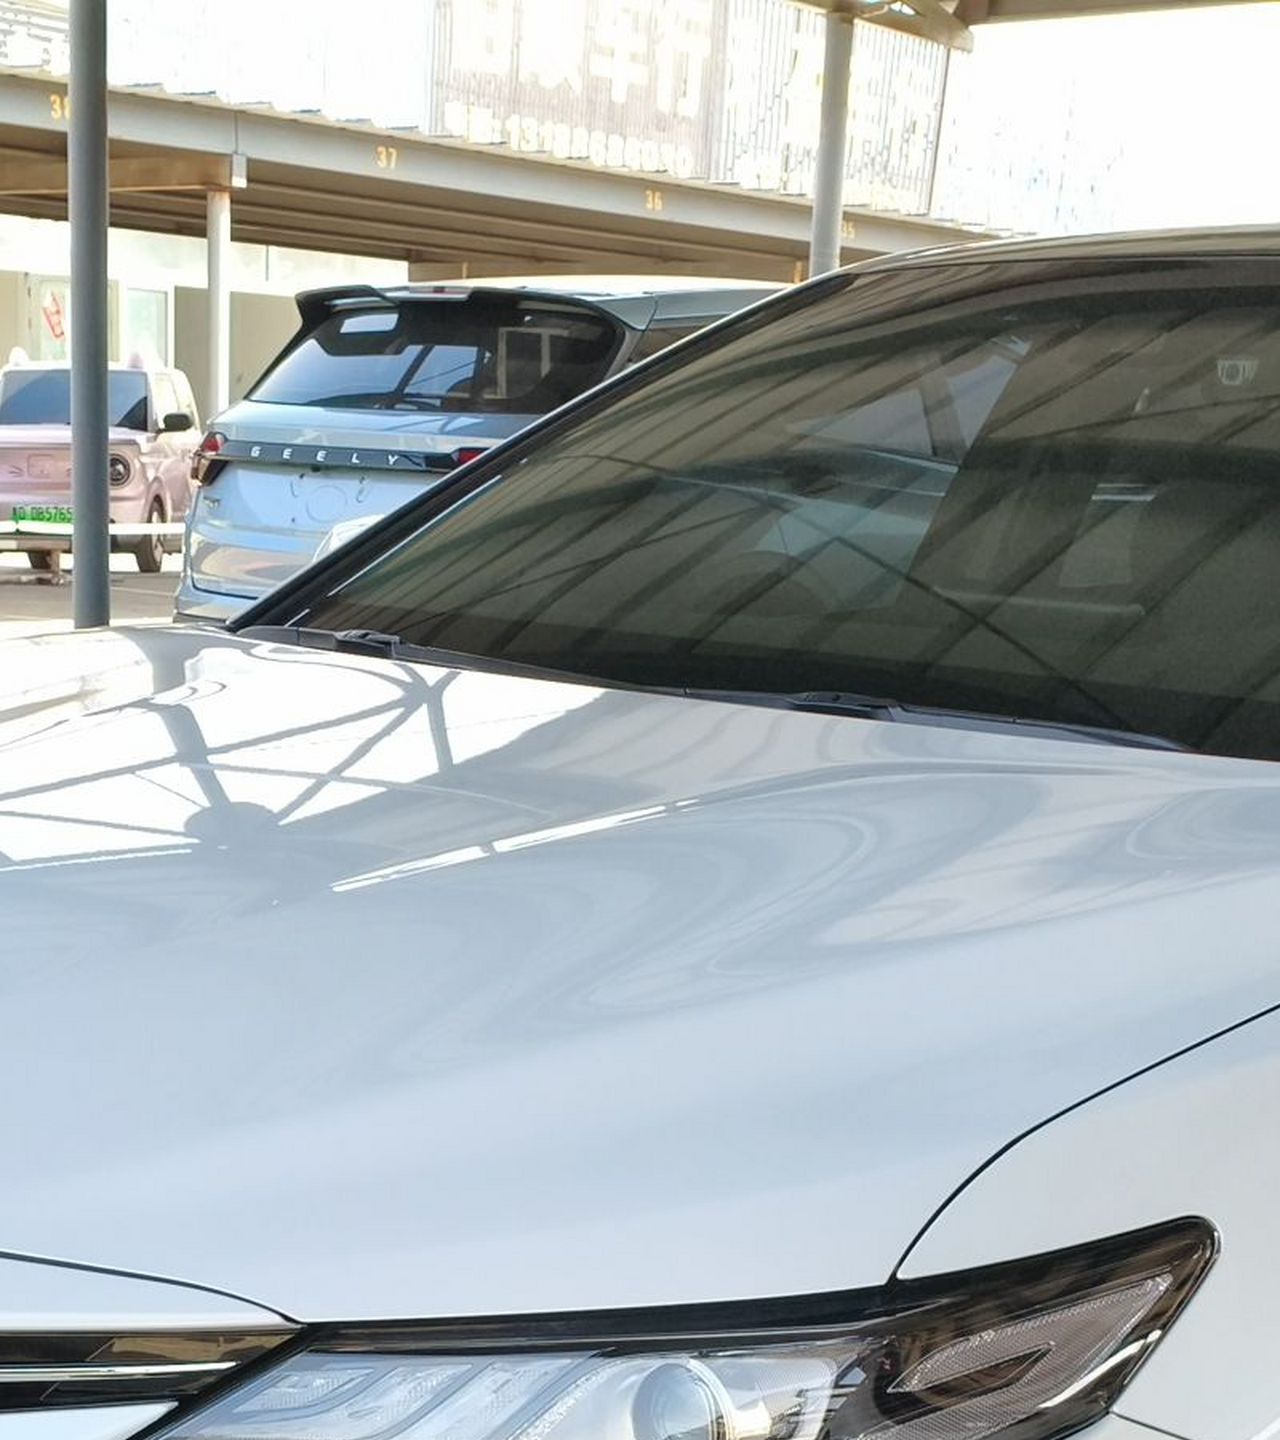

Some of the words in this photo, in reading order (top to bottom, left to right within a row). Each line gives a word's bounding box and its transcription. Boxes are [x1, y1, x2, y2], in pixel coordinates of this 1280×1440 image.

[377, 146, 397, 168] 37
[645, 190, 663, 210] 36
[250, 446, 399, 466] GEELY
